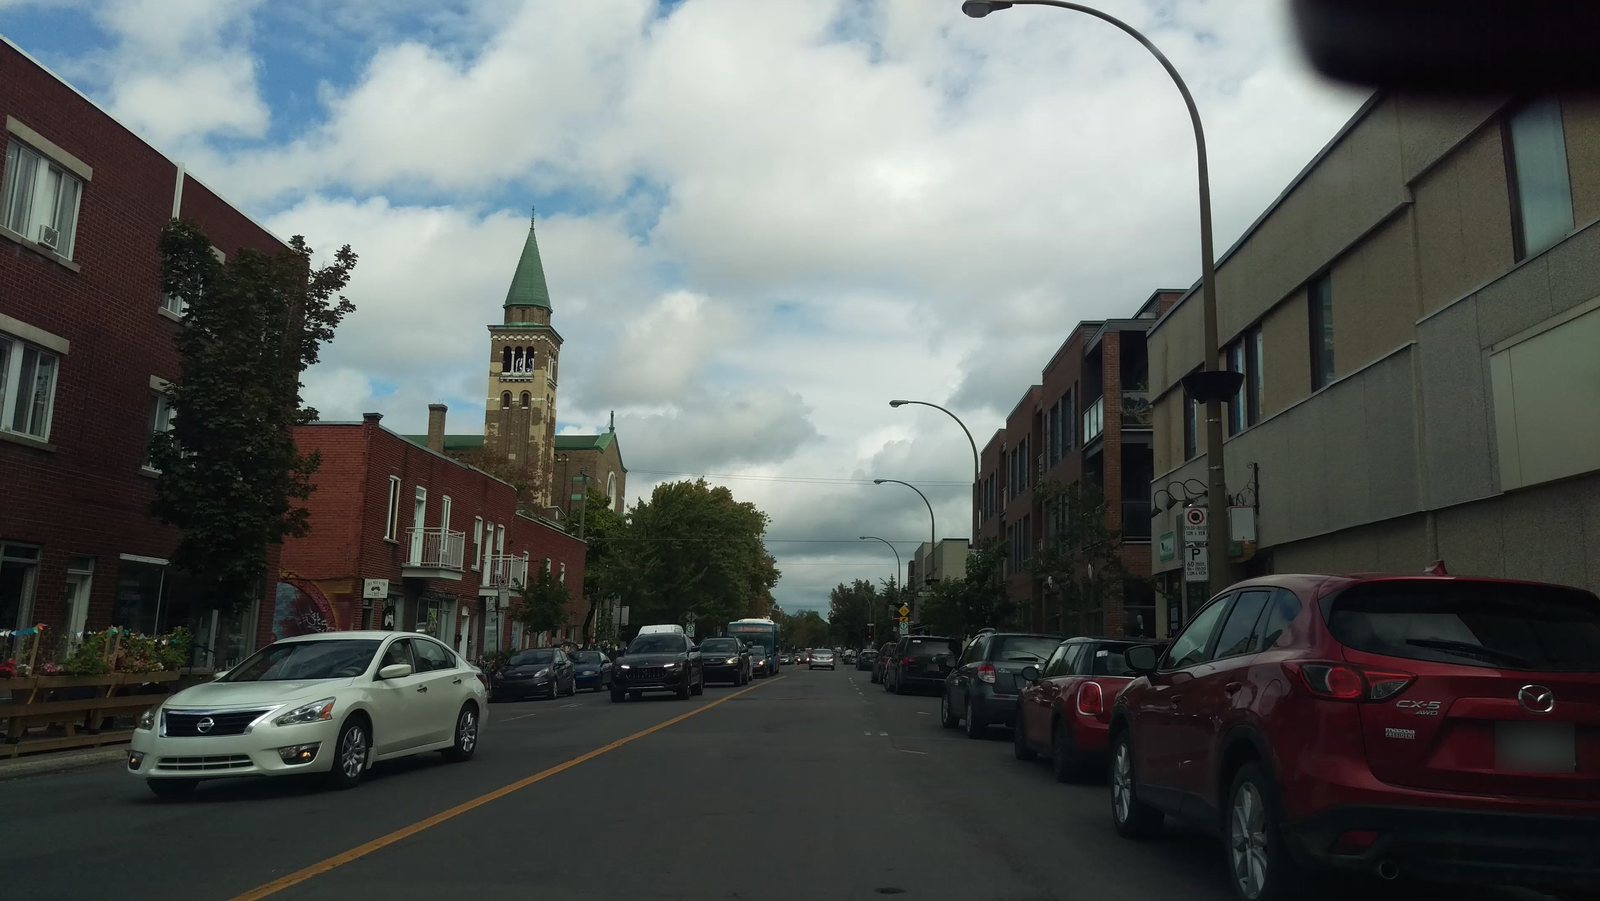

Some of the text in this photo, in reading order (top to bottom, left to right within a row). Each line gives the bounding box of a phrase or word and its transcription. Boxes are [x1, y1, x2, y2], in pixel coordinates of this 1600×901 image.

[1192, 549, 1200, 560] P
[1396, 700, 1441, 709] CX-5
[1385, 727, 1415, 735] mazda
